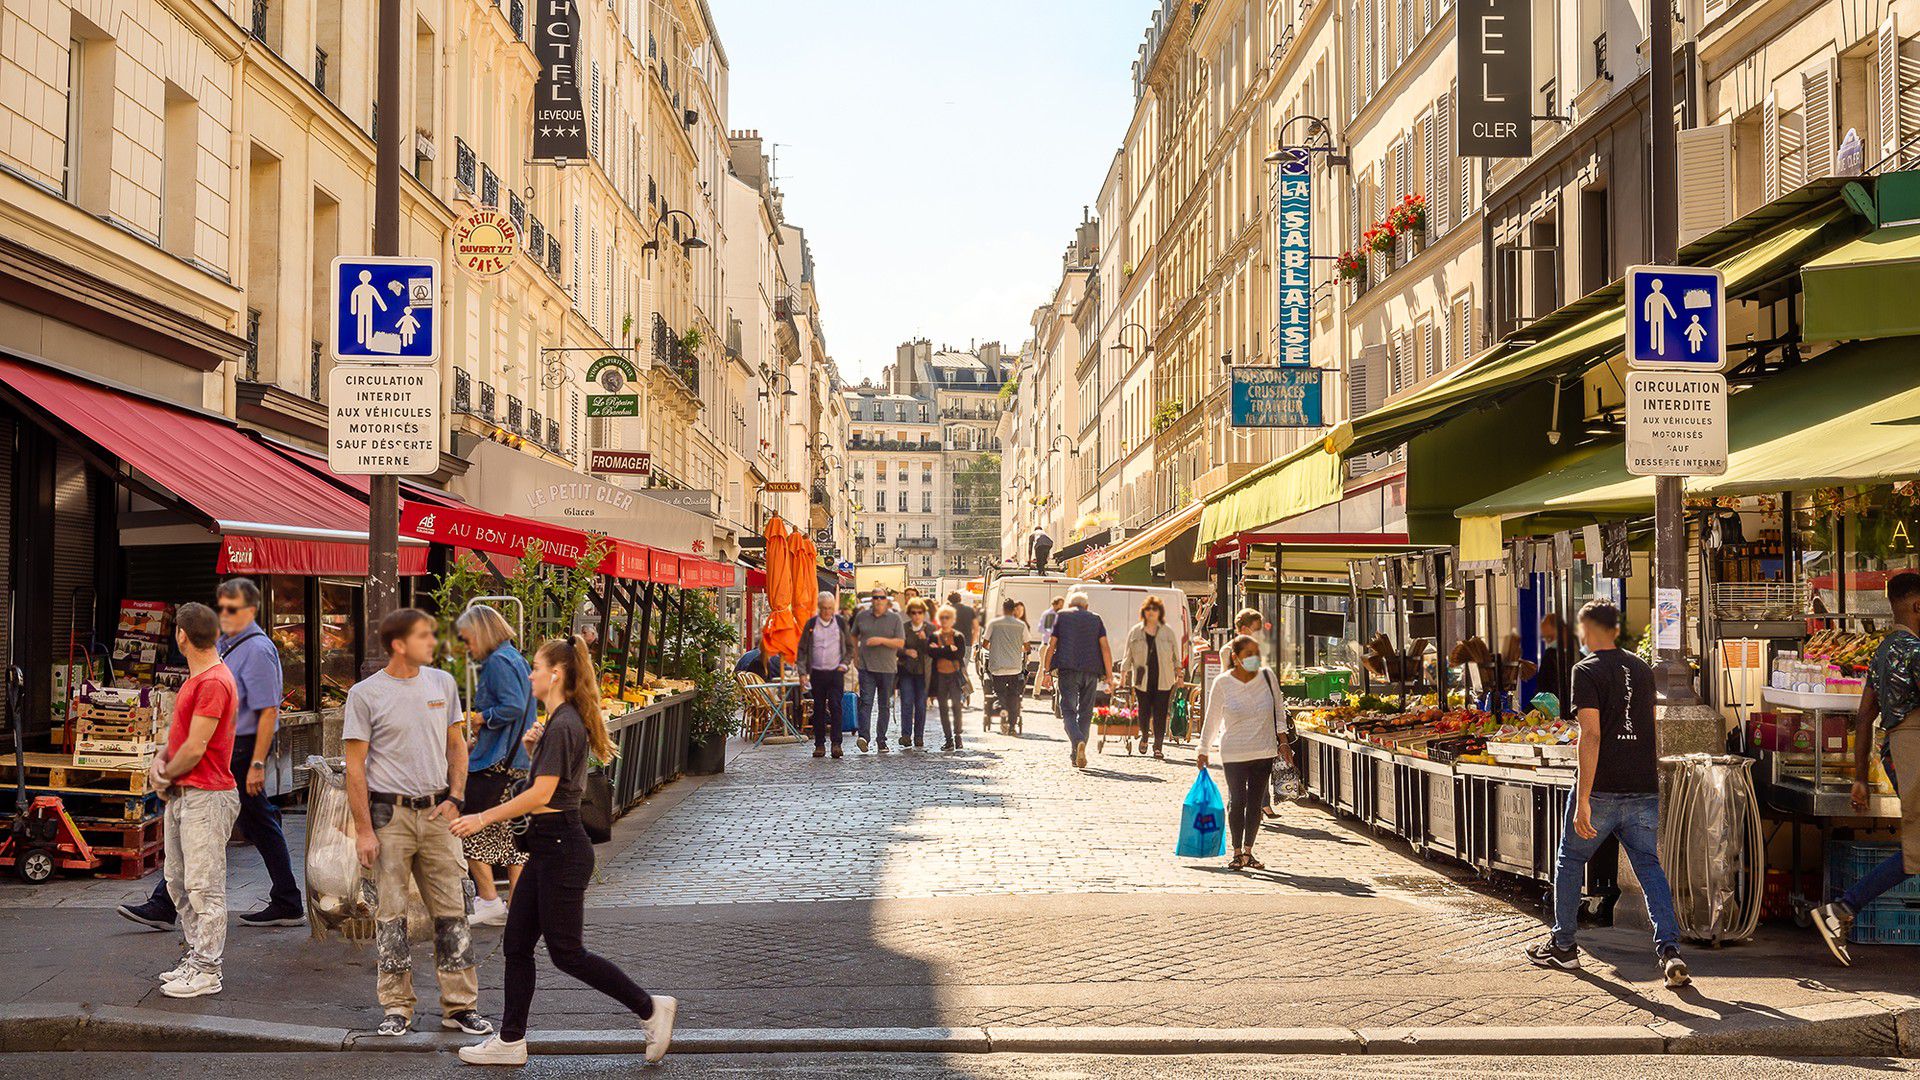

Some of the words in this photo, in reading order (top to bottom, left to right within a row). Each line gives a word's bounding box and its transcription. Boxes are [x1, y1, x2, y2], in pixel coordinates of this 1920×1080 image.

[1481, 0, 1505, 101] EL
[538, 110, 582, 121] LEVEQUE
[1472, 122, 1517, 138] CLER
[1282, 181, 1309, 197] LA
[468, 212, 495, 228] PETIT
[496, 218, 515, 240] CLER
[460, 245, 496, 253] OUVERT
[468, 256, 503, 272] CAFE
[1283, 211, 1305, 364] SABLAISE
[345, 376, 424, 386] CIRCULATION
[1296, 371, 1318, 384] FINS
[1635, 381, 1720, 394] CIRCULATION
[357, 392, 411, 402] INTERDIT
[592, 396, 605, 407] Le
[1643, 399, 1711, 411] INTERDITE
[337, 408, 360, 417] AUX
[365, 406, 432, 417] VÉHICULES
[592, 408, 601, 416] de
[1643, 417, 1660, 425] AUX
[1663, 416, 1712, 425] VÉHICULES
[349, 422, 419, 433] MOTORISÉS
[1652, 430, 1703, 439] MOTORISÉS
[336, 440, 367, 449] SAUF
[358, 456, 410, 466] INTERNE
[591, 455, 650, 470] FROMAGER
[1635, 458, 1680, 467] DESSERTE
[1683, 459, 1721, 467] INTERNE
[526, 489, 547, 509] LE
[549, 483, 592, 501] PETIT
[596, 485, 633, 511] CLER
[564, 507, 595, 516] Glaces
[419, 516, 434, 528] AB
[448, 522, 472, 538] AU
[475, 528, 506, 545] BON
[509, 532, 579, 559] JARDINIER
